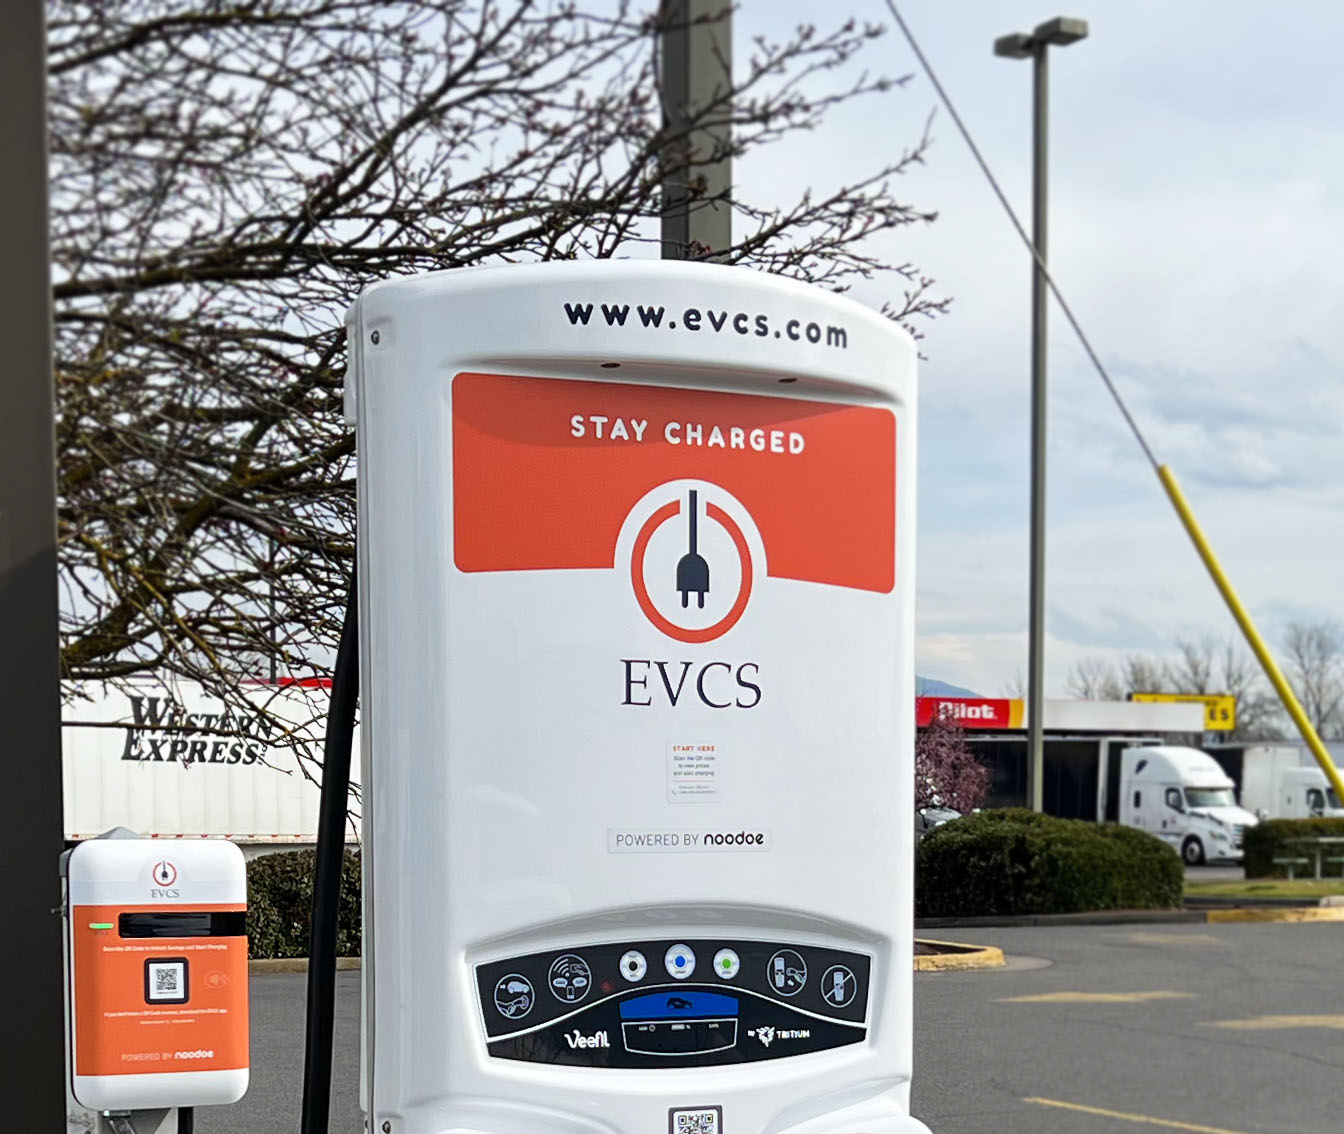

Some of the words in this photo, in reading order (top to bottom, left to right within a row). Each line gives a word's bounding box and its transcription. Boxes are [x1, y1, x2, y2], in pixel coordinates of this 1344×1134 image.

[563, 302, 848, 349] www.evcs.com
[570, 415, 648, 442] STAY
[664, 421, 805, 454] CHARGED
[620, 659, 762, 709] EVCS
[939, 701, 995, 719] Pilot
[121, 727, 259, 765] EXPRESS
[616, 833, 679, 846] POWERED
[683, 833, 699, 846] BY
[704, 831, 764, 846] noodoe
[151, 889, 180, 898] EVCS
[121, 1052, 160, 1062] POWERED
[174, 1049, 214, 1060] noodoe
